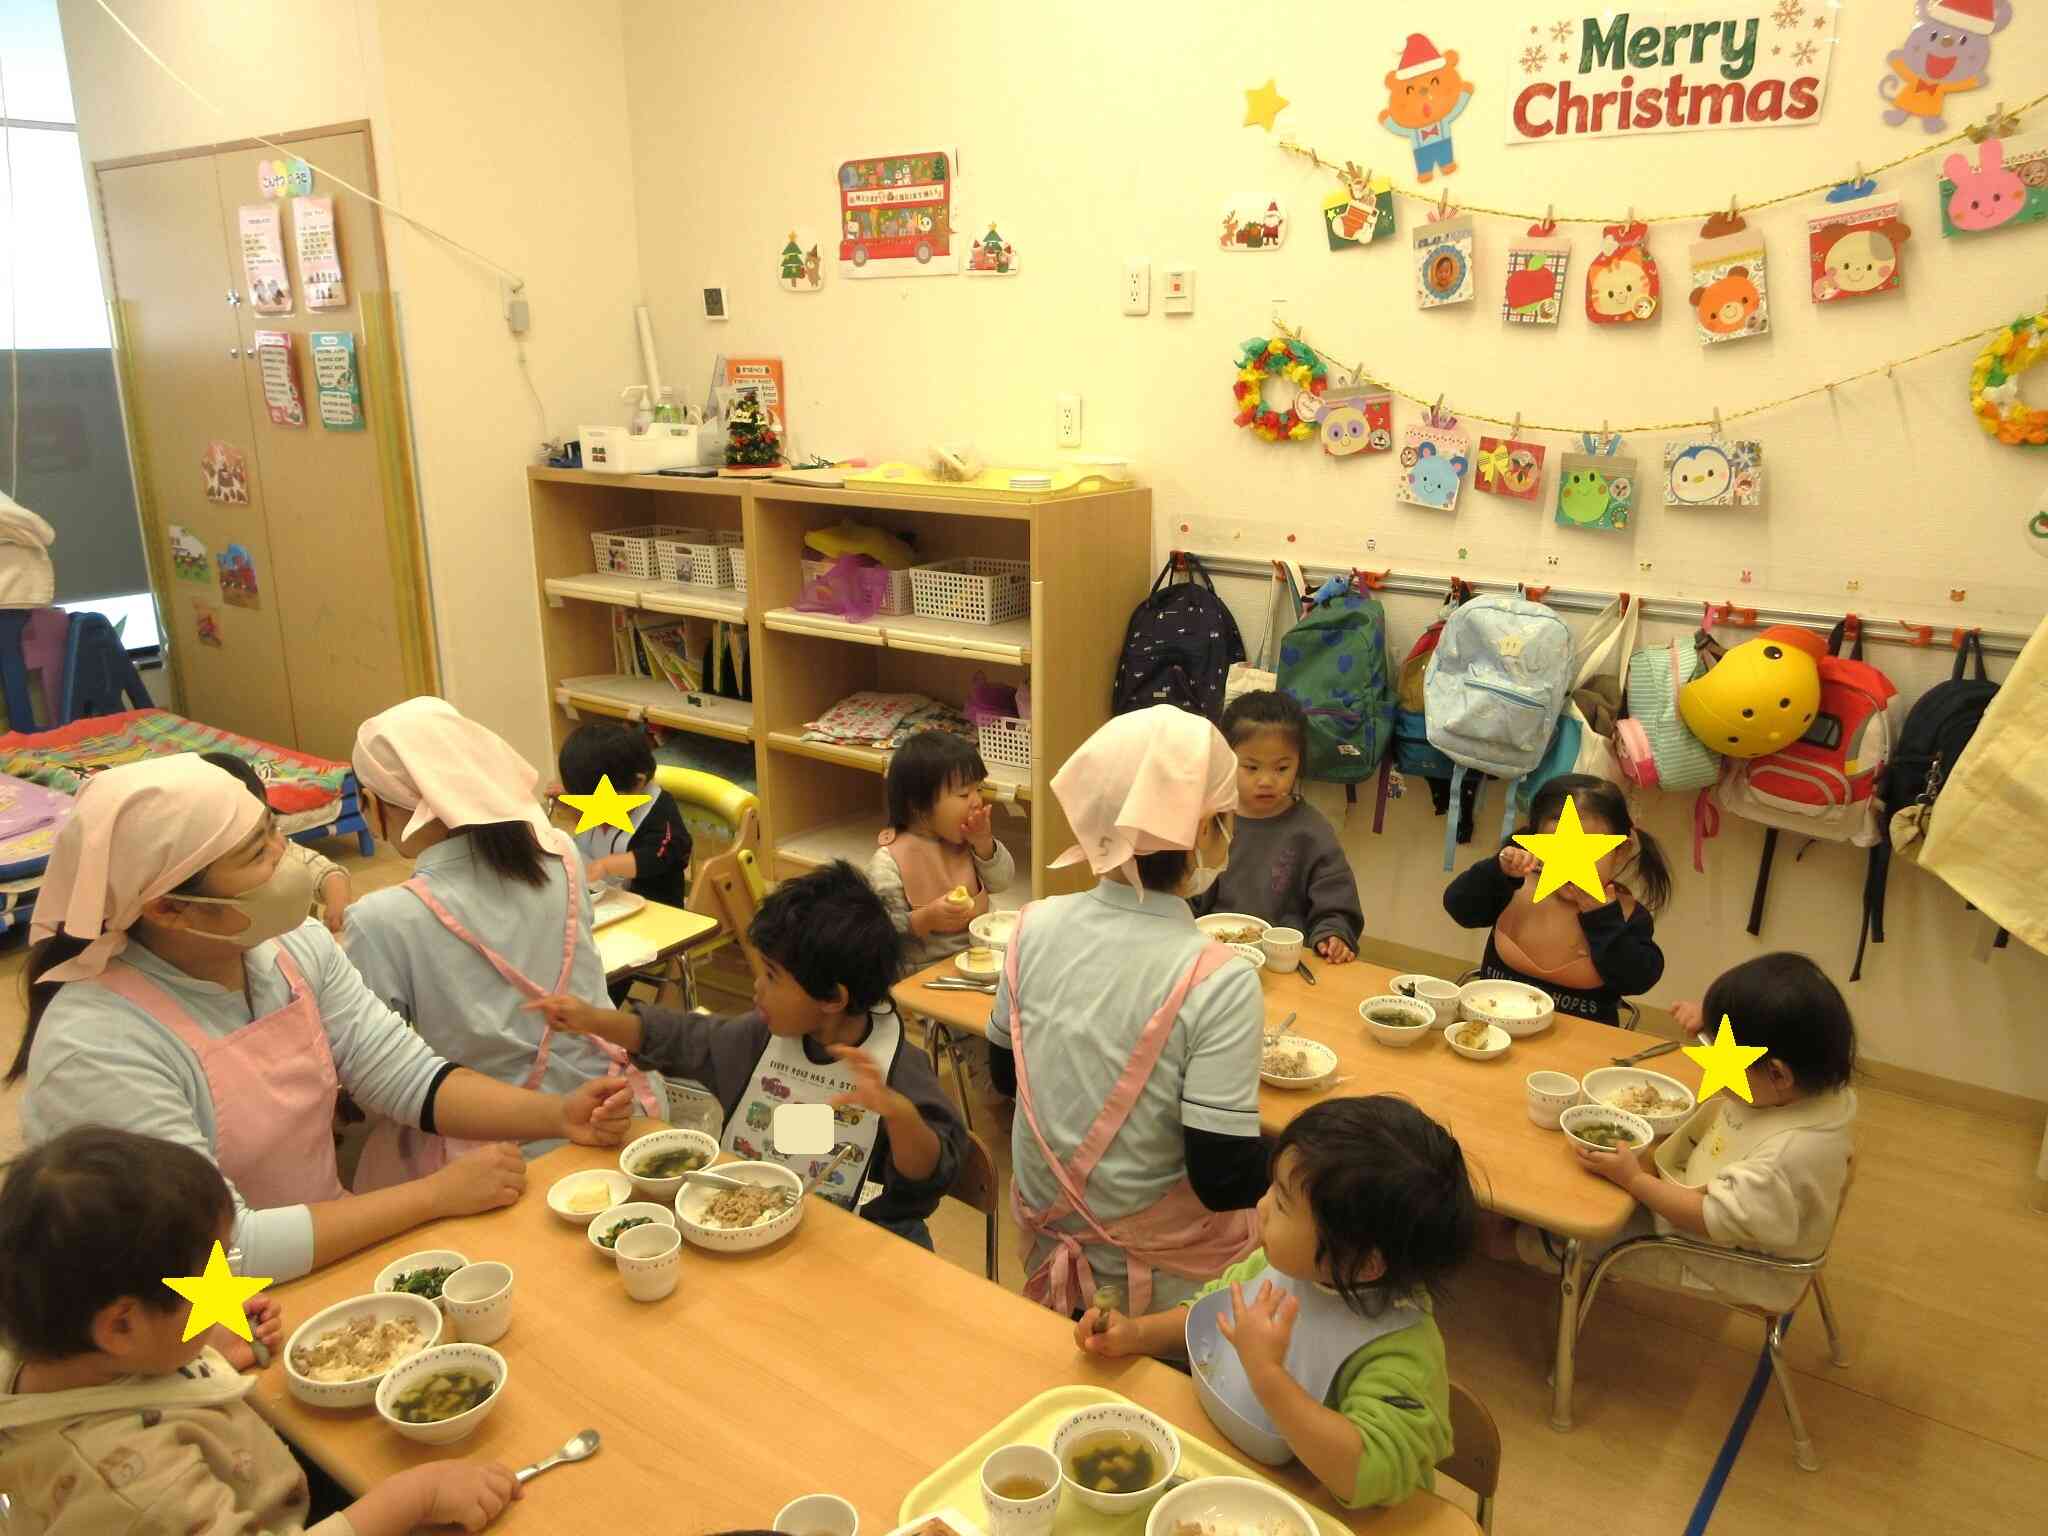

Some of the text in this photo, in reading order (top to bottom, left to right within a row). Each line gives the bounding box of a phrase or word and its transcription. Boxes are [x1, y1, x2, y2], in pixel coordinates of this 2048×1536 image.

[1578, 13, 1759, 80] Merry
[1513, 74, 1820, 138] Christmas
[1552, 991, 1598, 1014] HOPES
[769, 1060, 789, 1073] EVERY
[791, 1067, 809, 1079] ROAD
[810, 1073, 826, 1084] HAS
